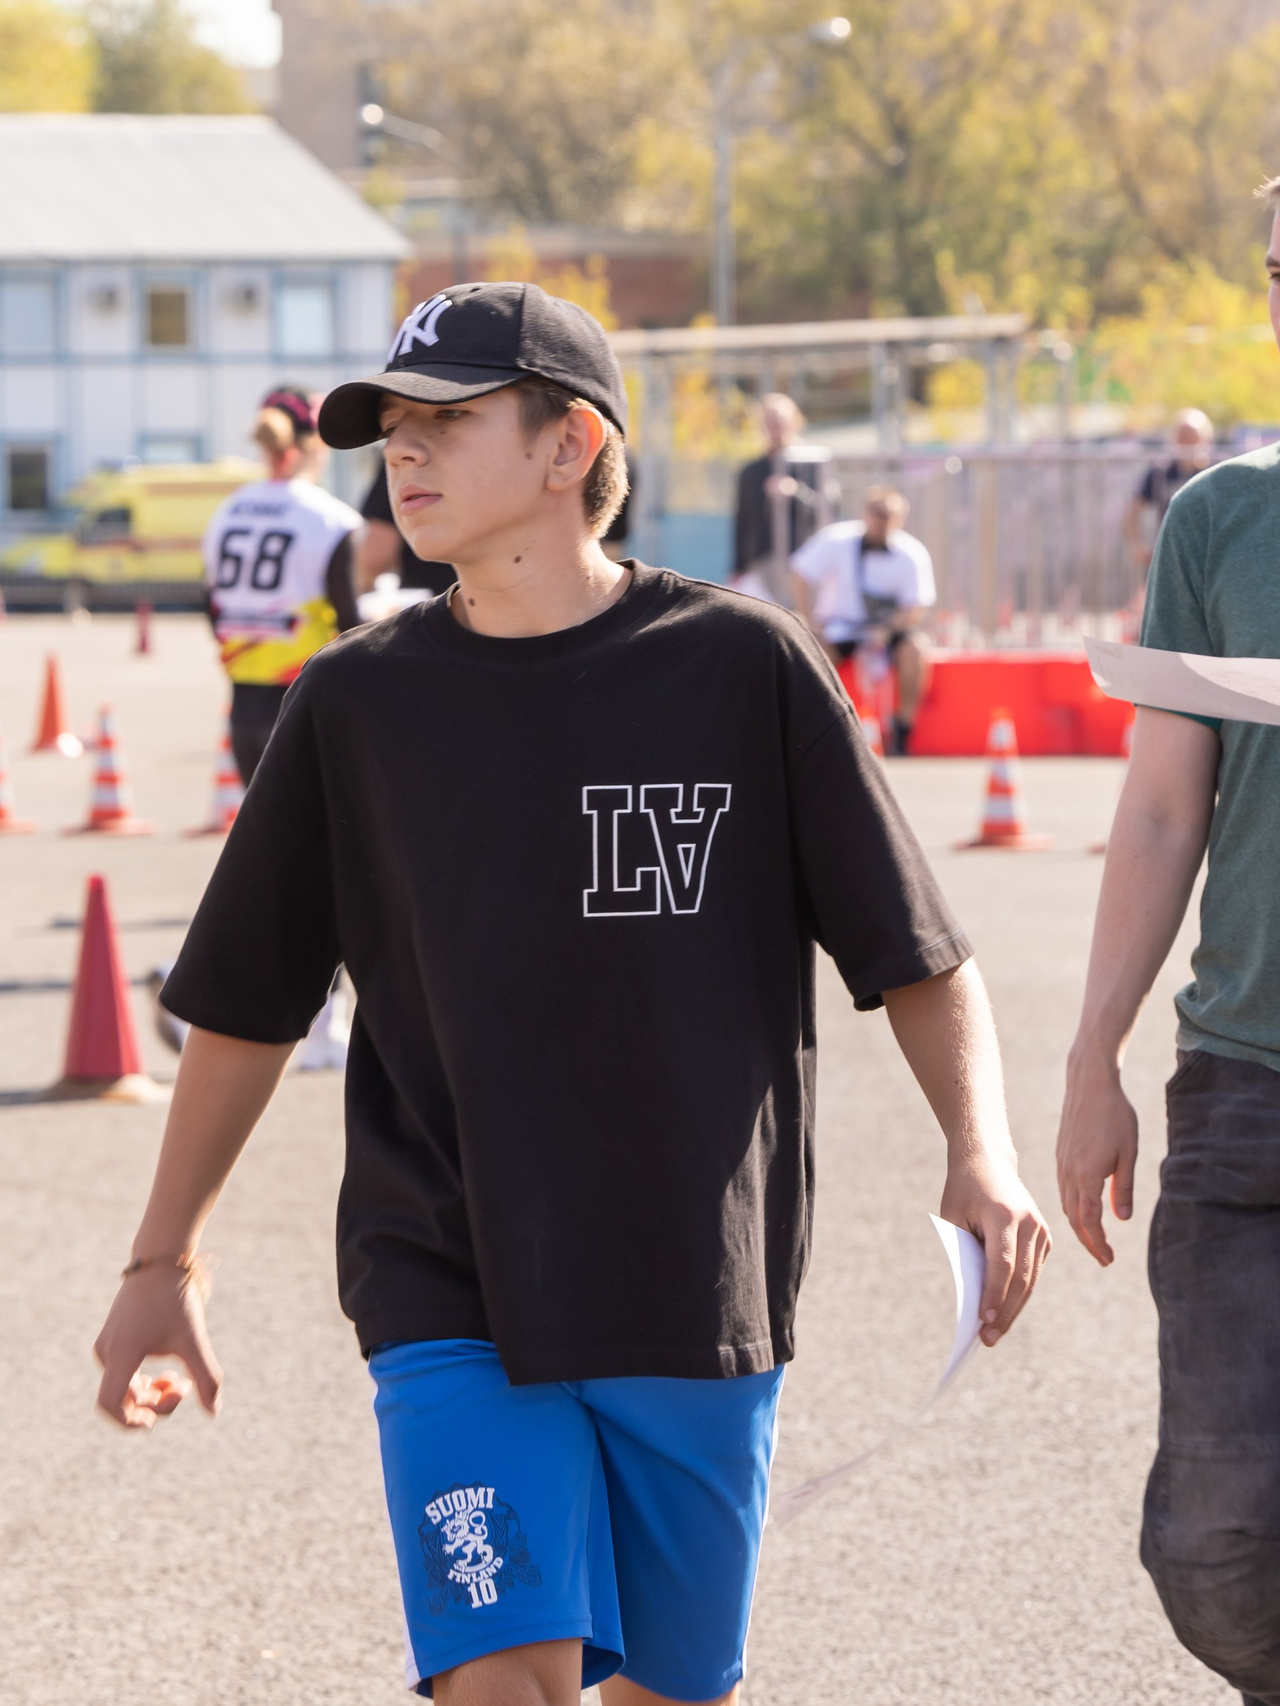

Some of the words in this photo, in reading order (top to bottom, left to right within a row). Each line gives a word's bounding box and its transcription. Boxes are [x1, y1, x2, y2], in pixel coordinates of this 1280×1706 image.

[425, 1487, 495, 1525] SUOMI
[447, 1556, 504, 1584] FINLAND
[468, 1578, 498, 1609] 10
